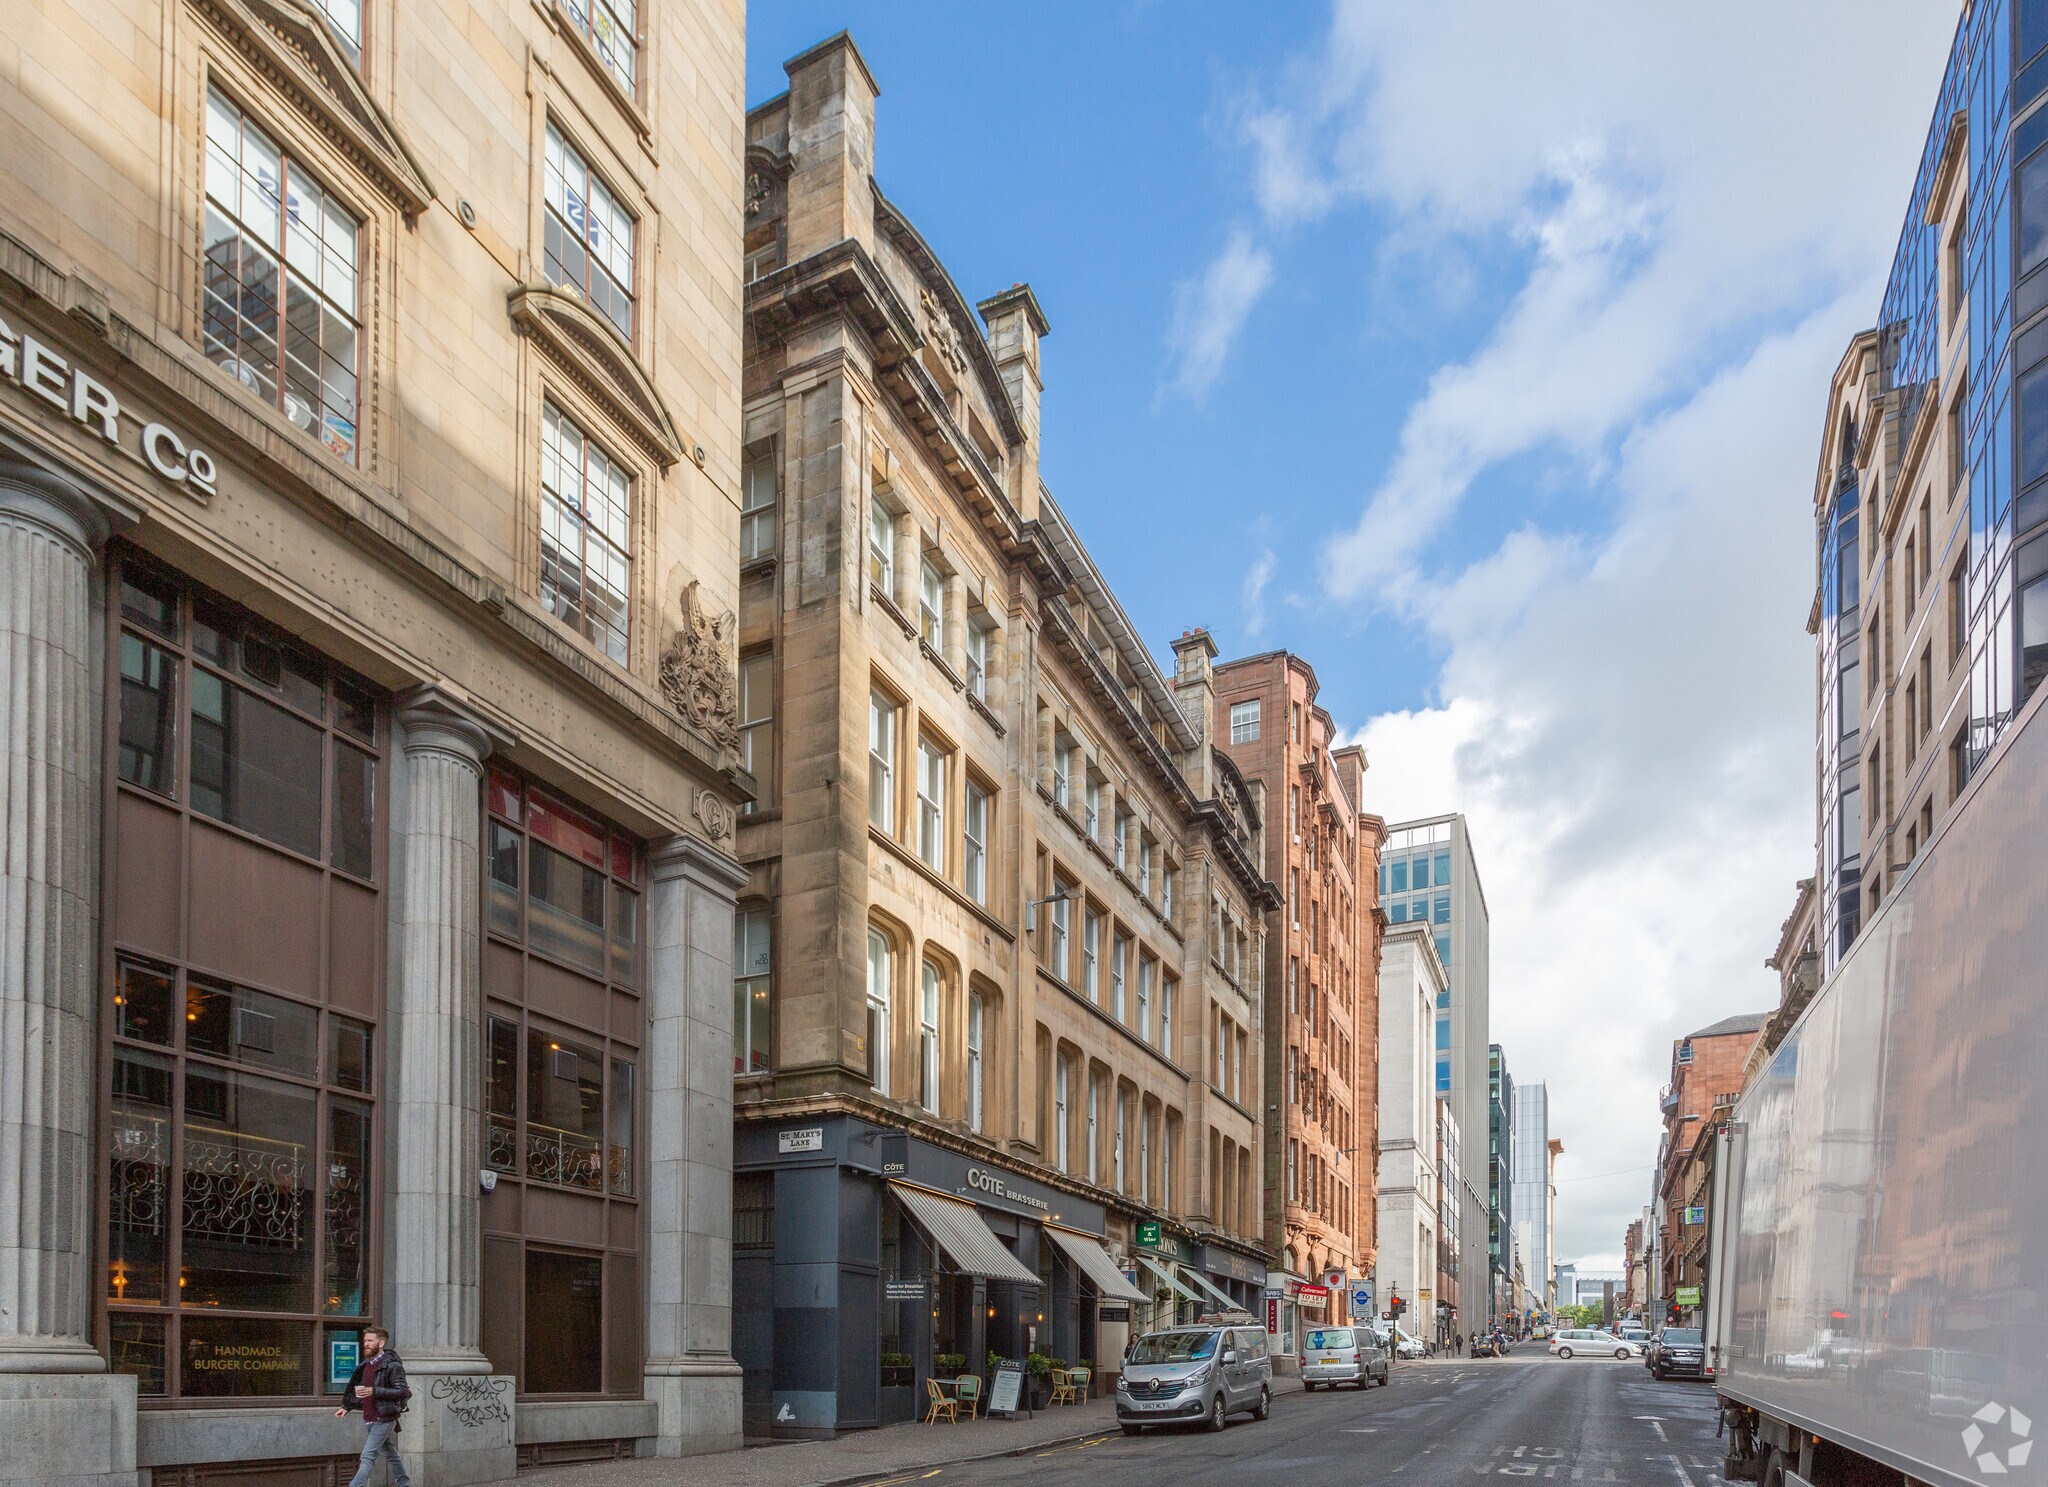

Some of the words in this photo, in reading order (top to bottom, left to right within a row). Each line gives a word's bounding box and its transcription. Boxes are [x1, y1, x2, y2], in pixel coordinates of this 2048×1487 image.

[884, 1163, 904, 1171] CÔTE
[967, 1168, 1005, 1196] CÔTE
[1006, 1190, 1049, 1210] BRASSERIE
[1301, 1286, 1327, 1295] Culverwell
[214, 1345, 282, 1357] HANDMADE
[194, 1359, 240, 1370] BURGER
[243, 1360, 299, 1371] COMPANY
